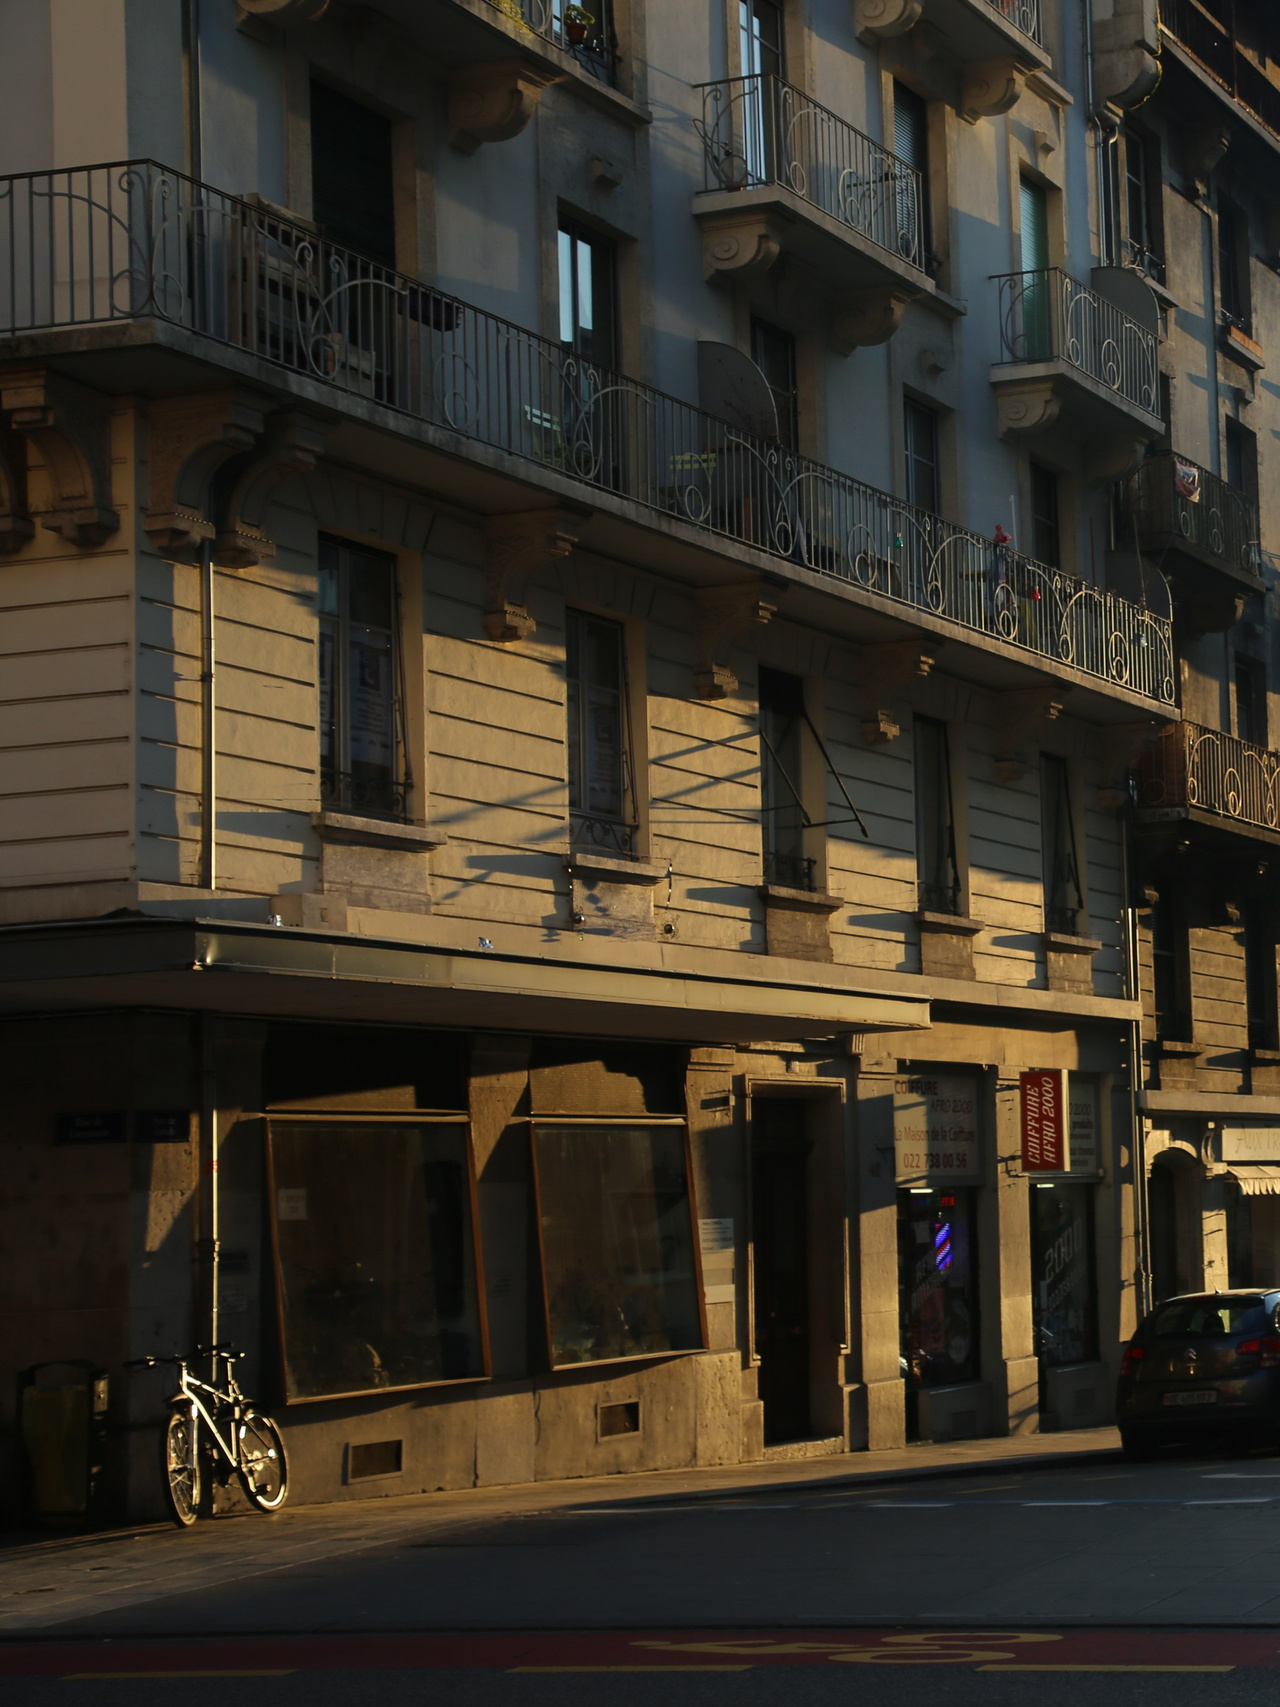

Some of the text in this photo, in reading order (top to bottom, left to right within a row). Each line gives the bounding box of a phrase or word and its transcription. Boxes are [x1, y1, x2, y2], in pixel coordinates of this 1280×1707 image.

[894, 1080, 938, 1096] COIFFURE
[929, 1099, 973, 1114] AFRO 2000
[1026, 1084, 1041, 1164] COIFFURE
[1041, 1077, 1057, 1163] AFRO 2000
[894, 1125, 975, 1143] La Maison de la Coiffure
[903, 1153, 968, 1169] 022 738 00 56
[1045, 1218, 1082, 1285] 2000
